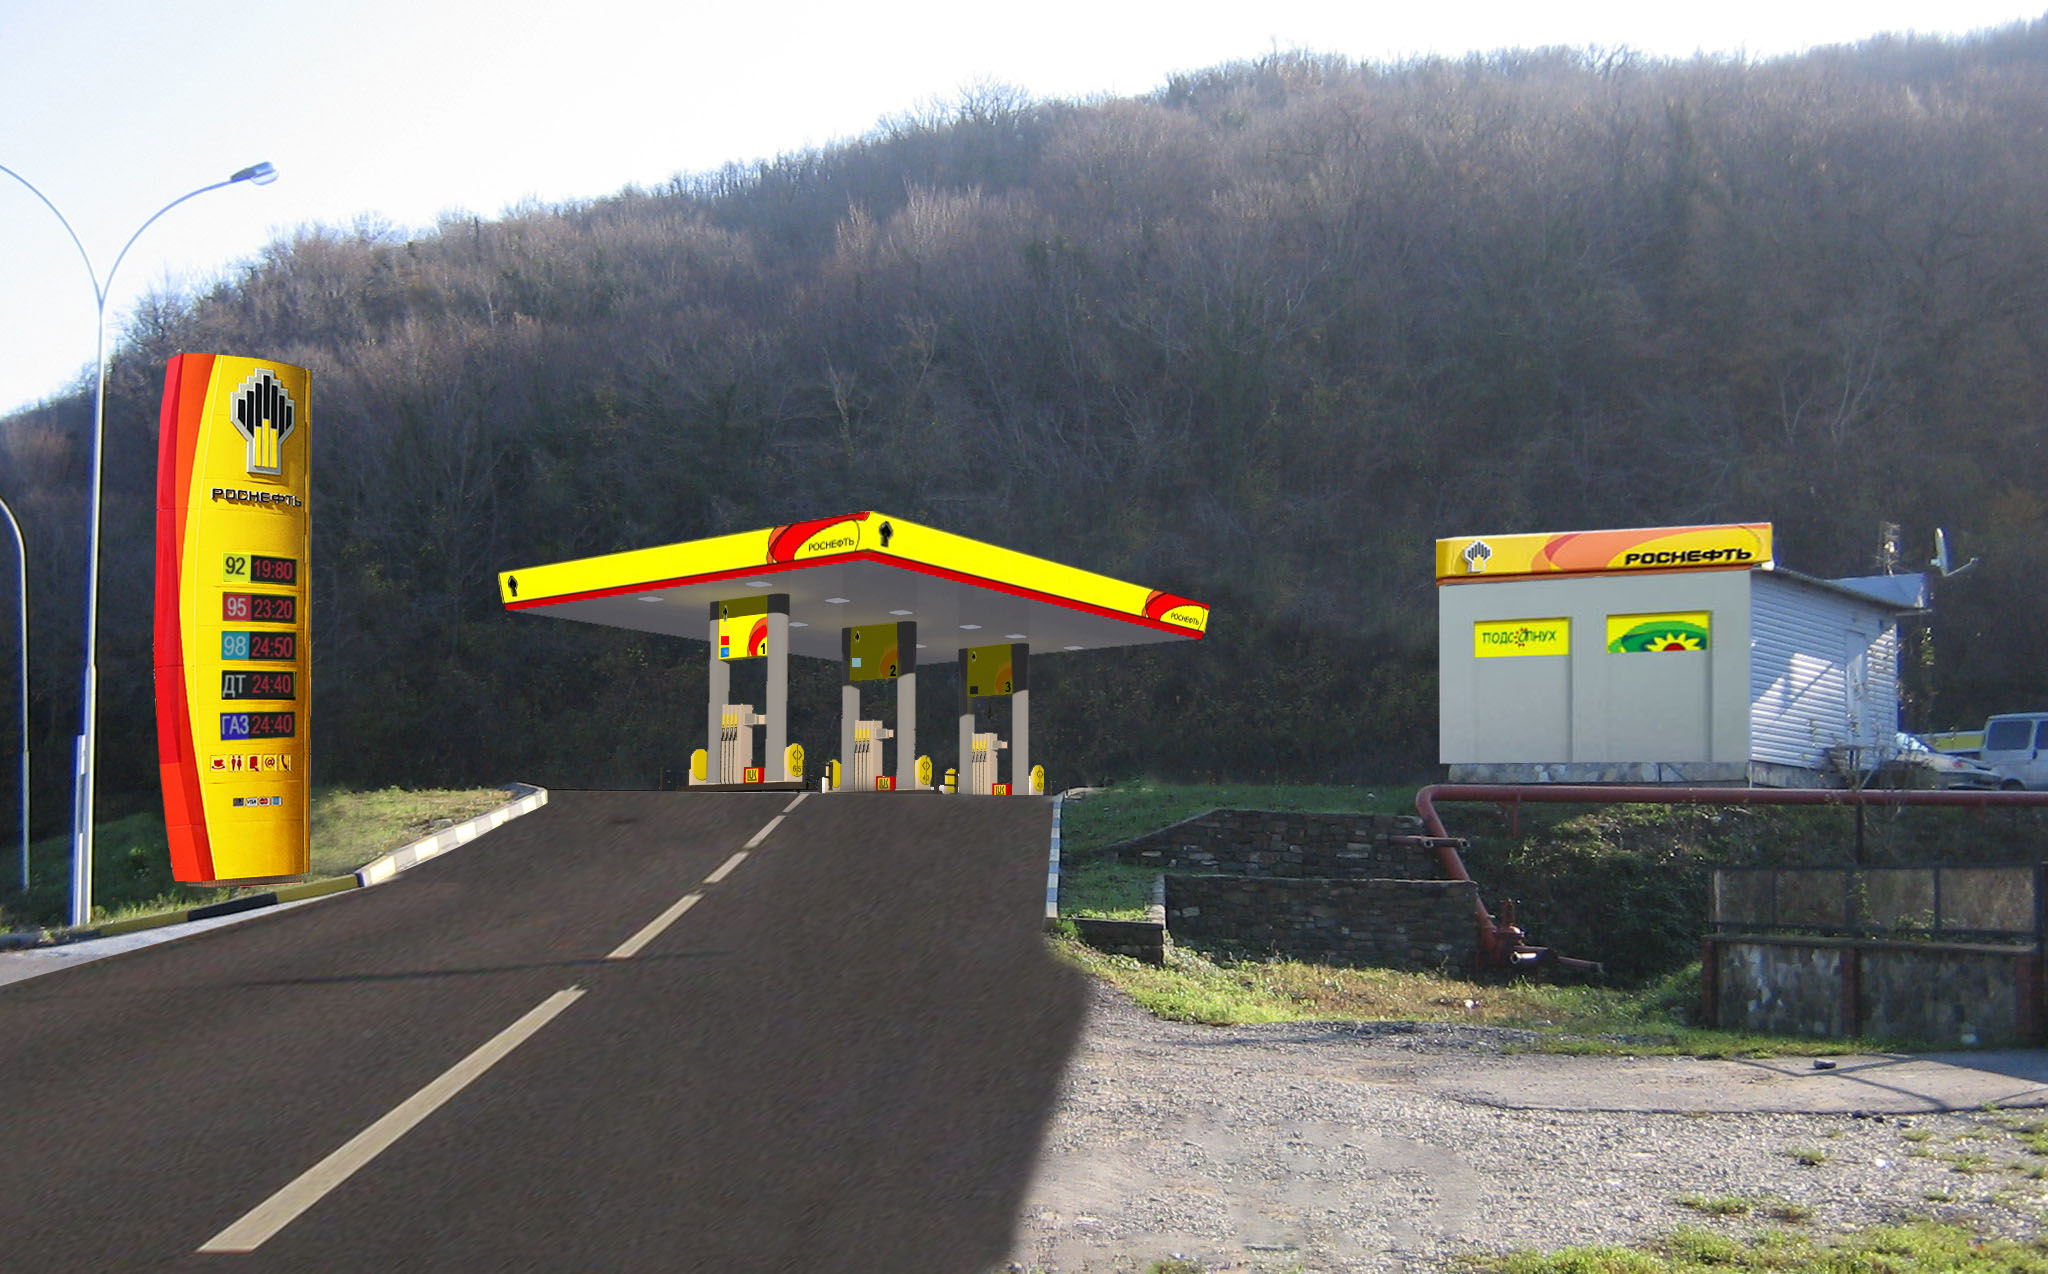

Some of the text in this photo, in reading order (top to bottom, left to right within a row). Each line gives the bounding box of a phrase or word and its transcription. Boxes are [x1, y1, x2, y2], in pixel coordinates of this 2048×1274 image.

[211, 487, 302, 508] РОСНЕФТЬ
[808, 537, 855, 552] РОСНЕФТЬ
[1625, 548, 1751, 566] РОСНЕФТЬ
[226, 556, 292, 579] 92 19:80
[227, 597, 292, 618] 95 23:20
[224, 636, 292, 657] 98 24:50
[761, 643, 765, 654] 1
[890, 665, 896, 676] 2
[223, 675, 291, 697] ДТ 24:40
[1004, 682, 1010, 692] 3
[221, 715, 292, 735] ГАЗ 24:40
